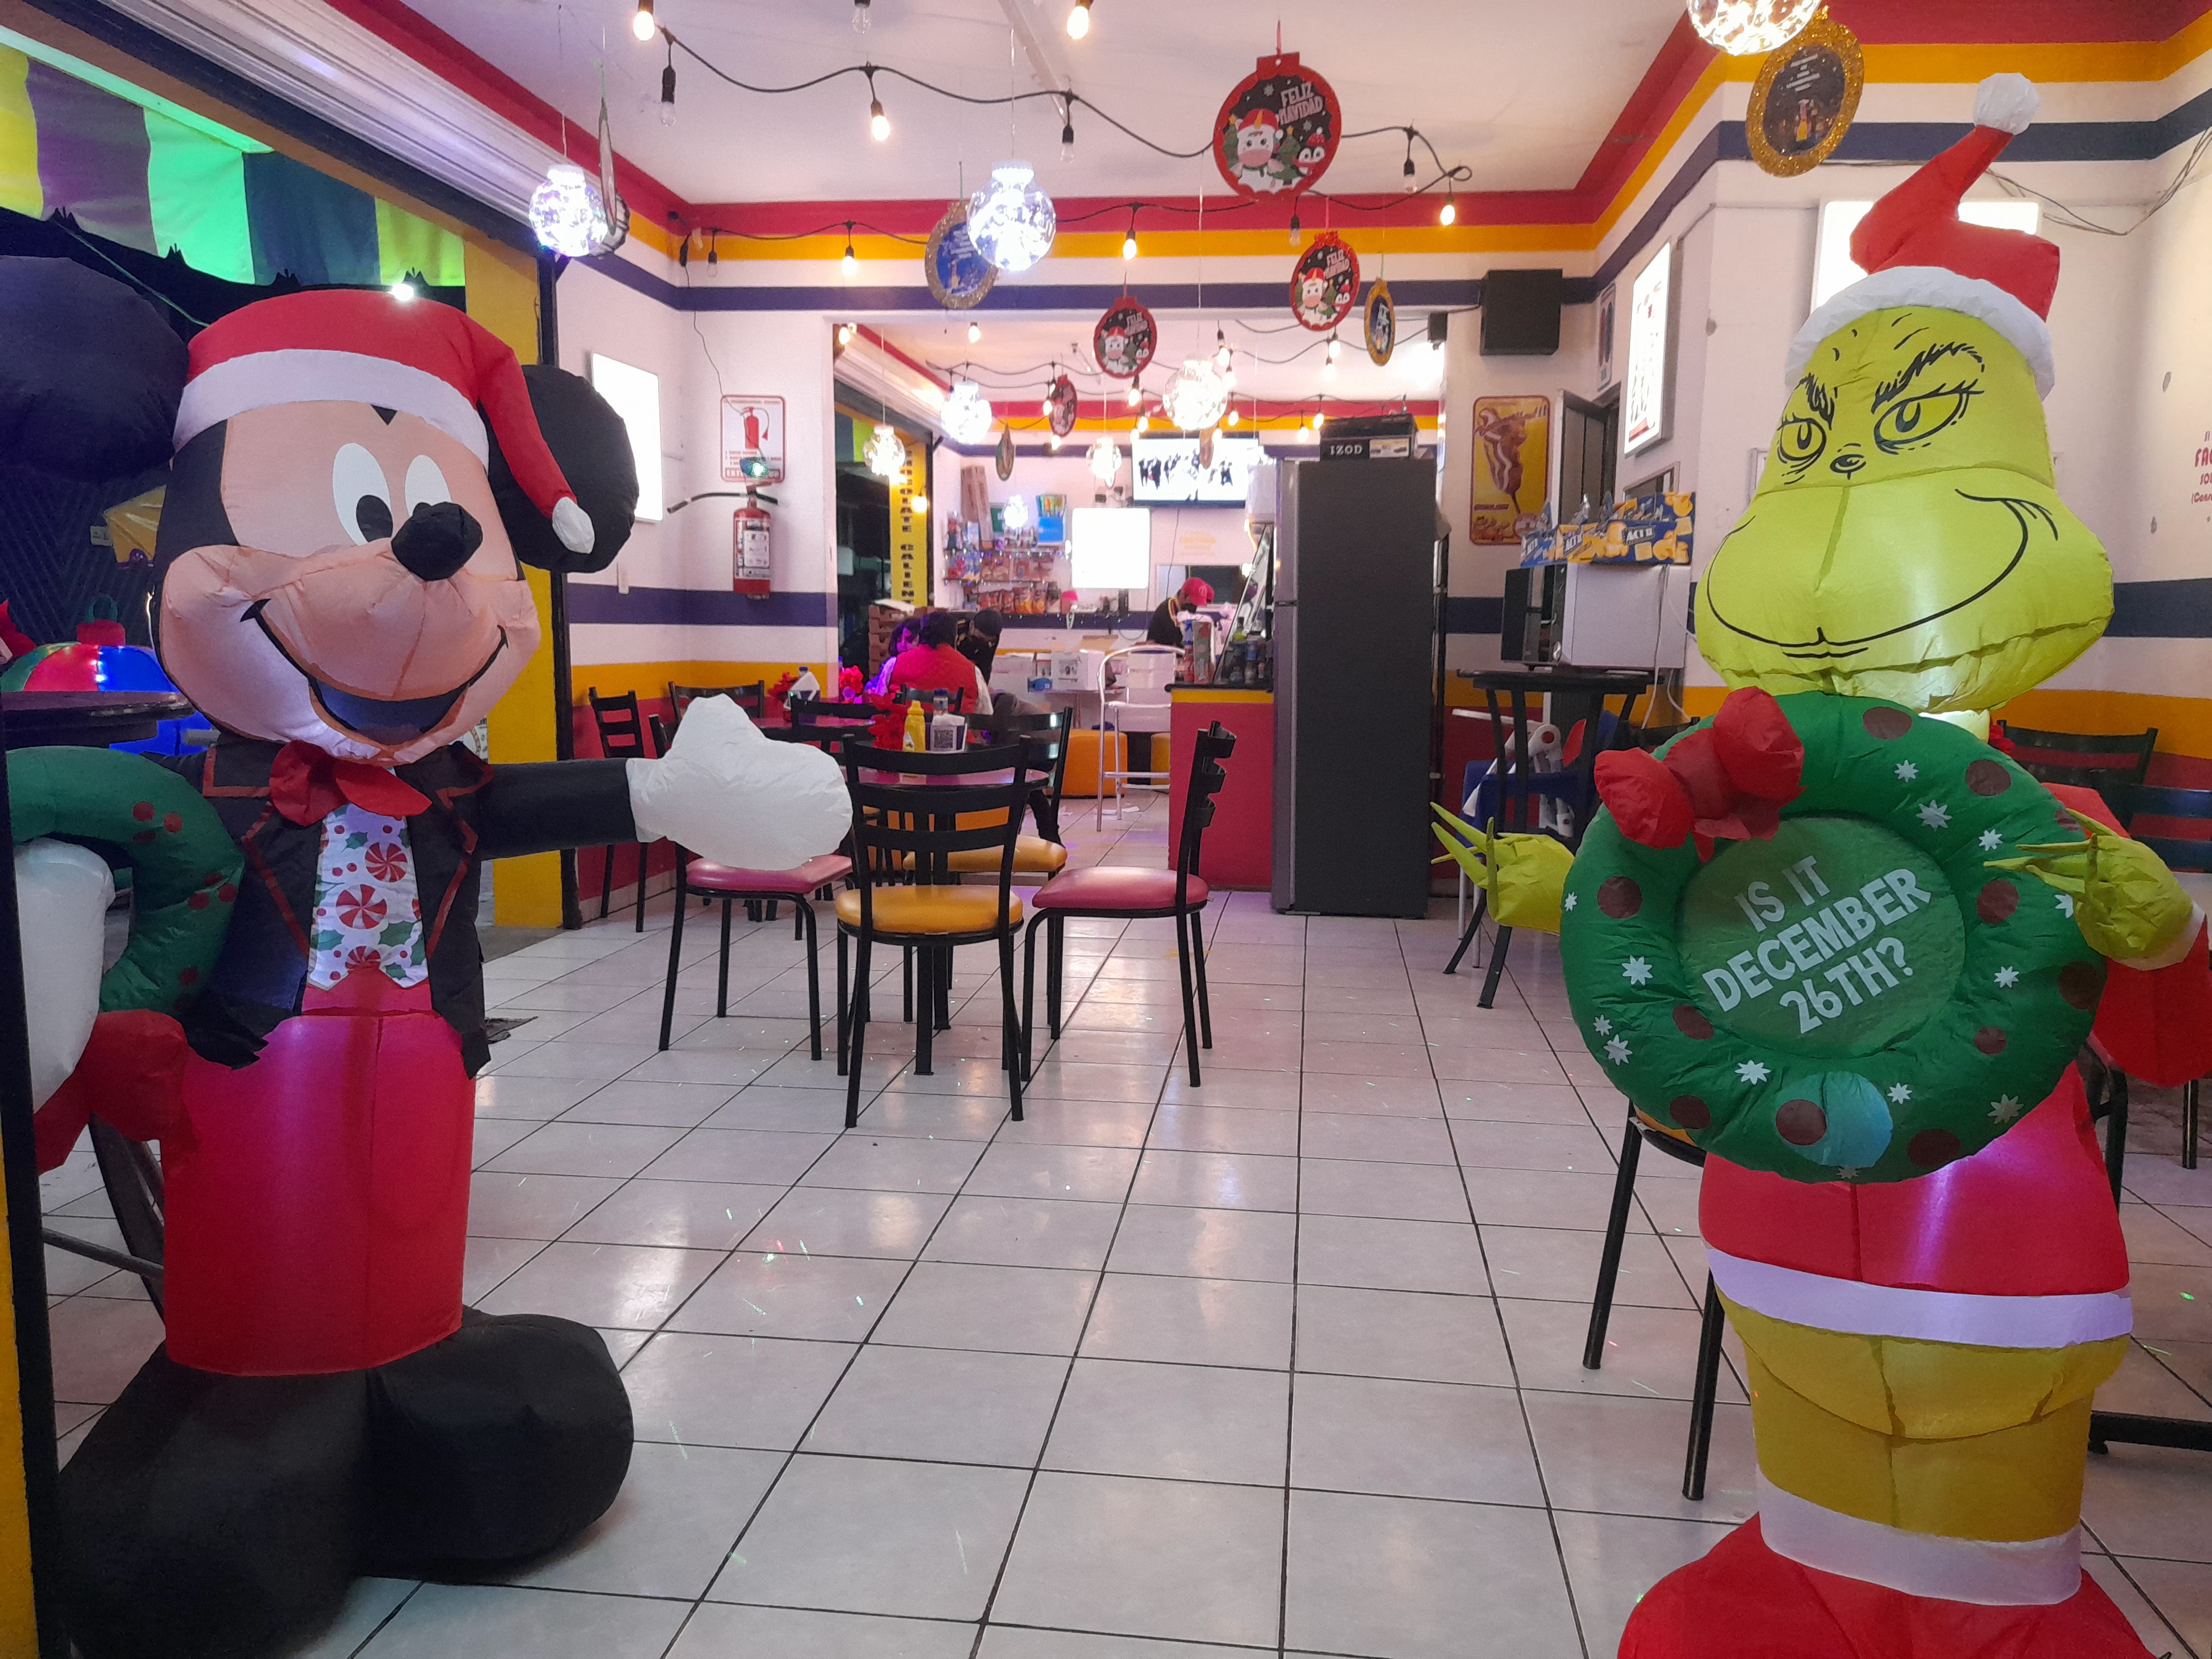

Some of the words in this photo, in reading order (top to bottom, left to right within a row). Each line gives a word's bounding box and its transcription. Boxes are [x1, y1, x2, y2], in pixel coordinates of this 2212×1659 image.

[1279, 95, 1323, 126] NAVIDAD
[1280, 81, 1316, 108] FELIZ
[1329, 444, 1363, 456] IZOD
[900, 544, 915, 604] CALIENT
[1735, 881, 1785, 933] IS
[1782, 855, 1830, 906] IT
[1702, 869, 1932, 1013] DECEMBER
[1779, 937, 1913, 1034] 26TH?
